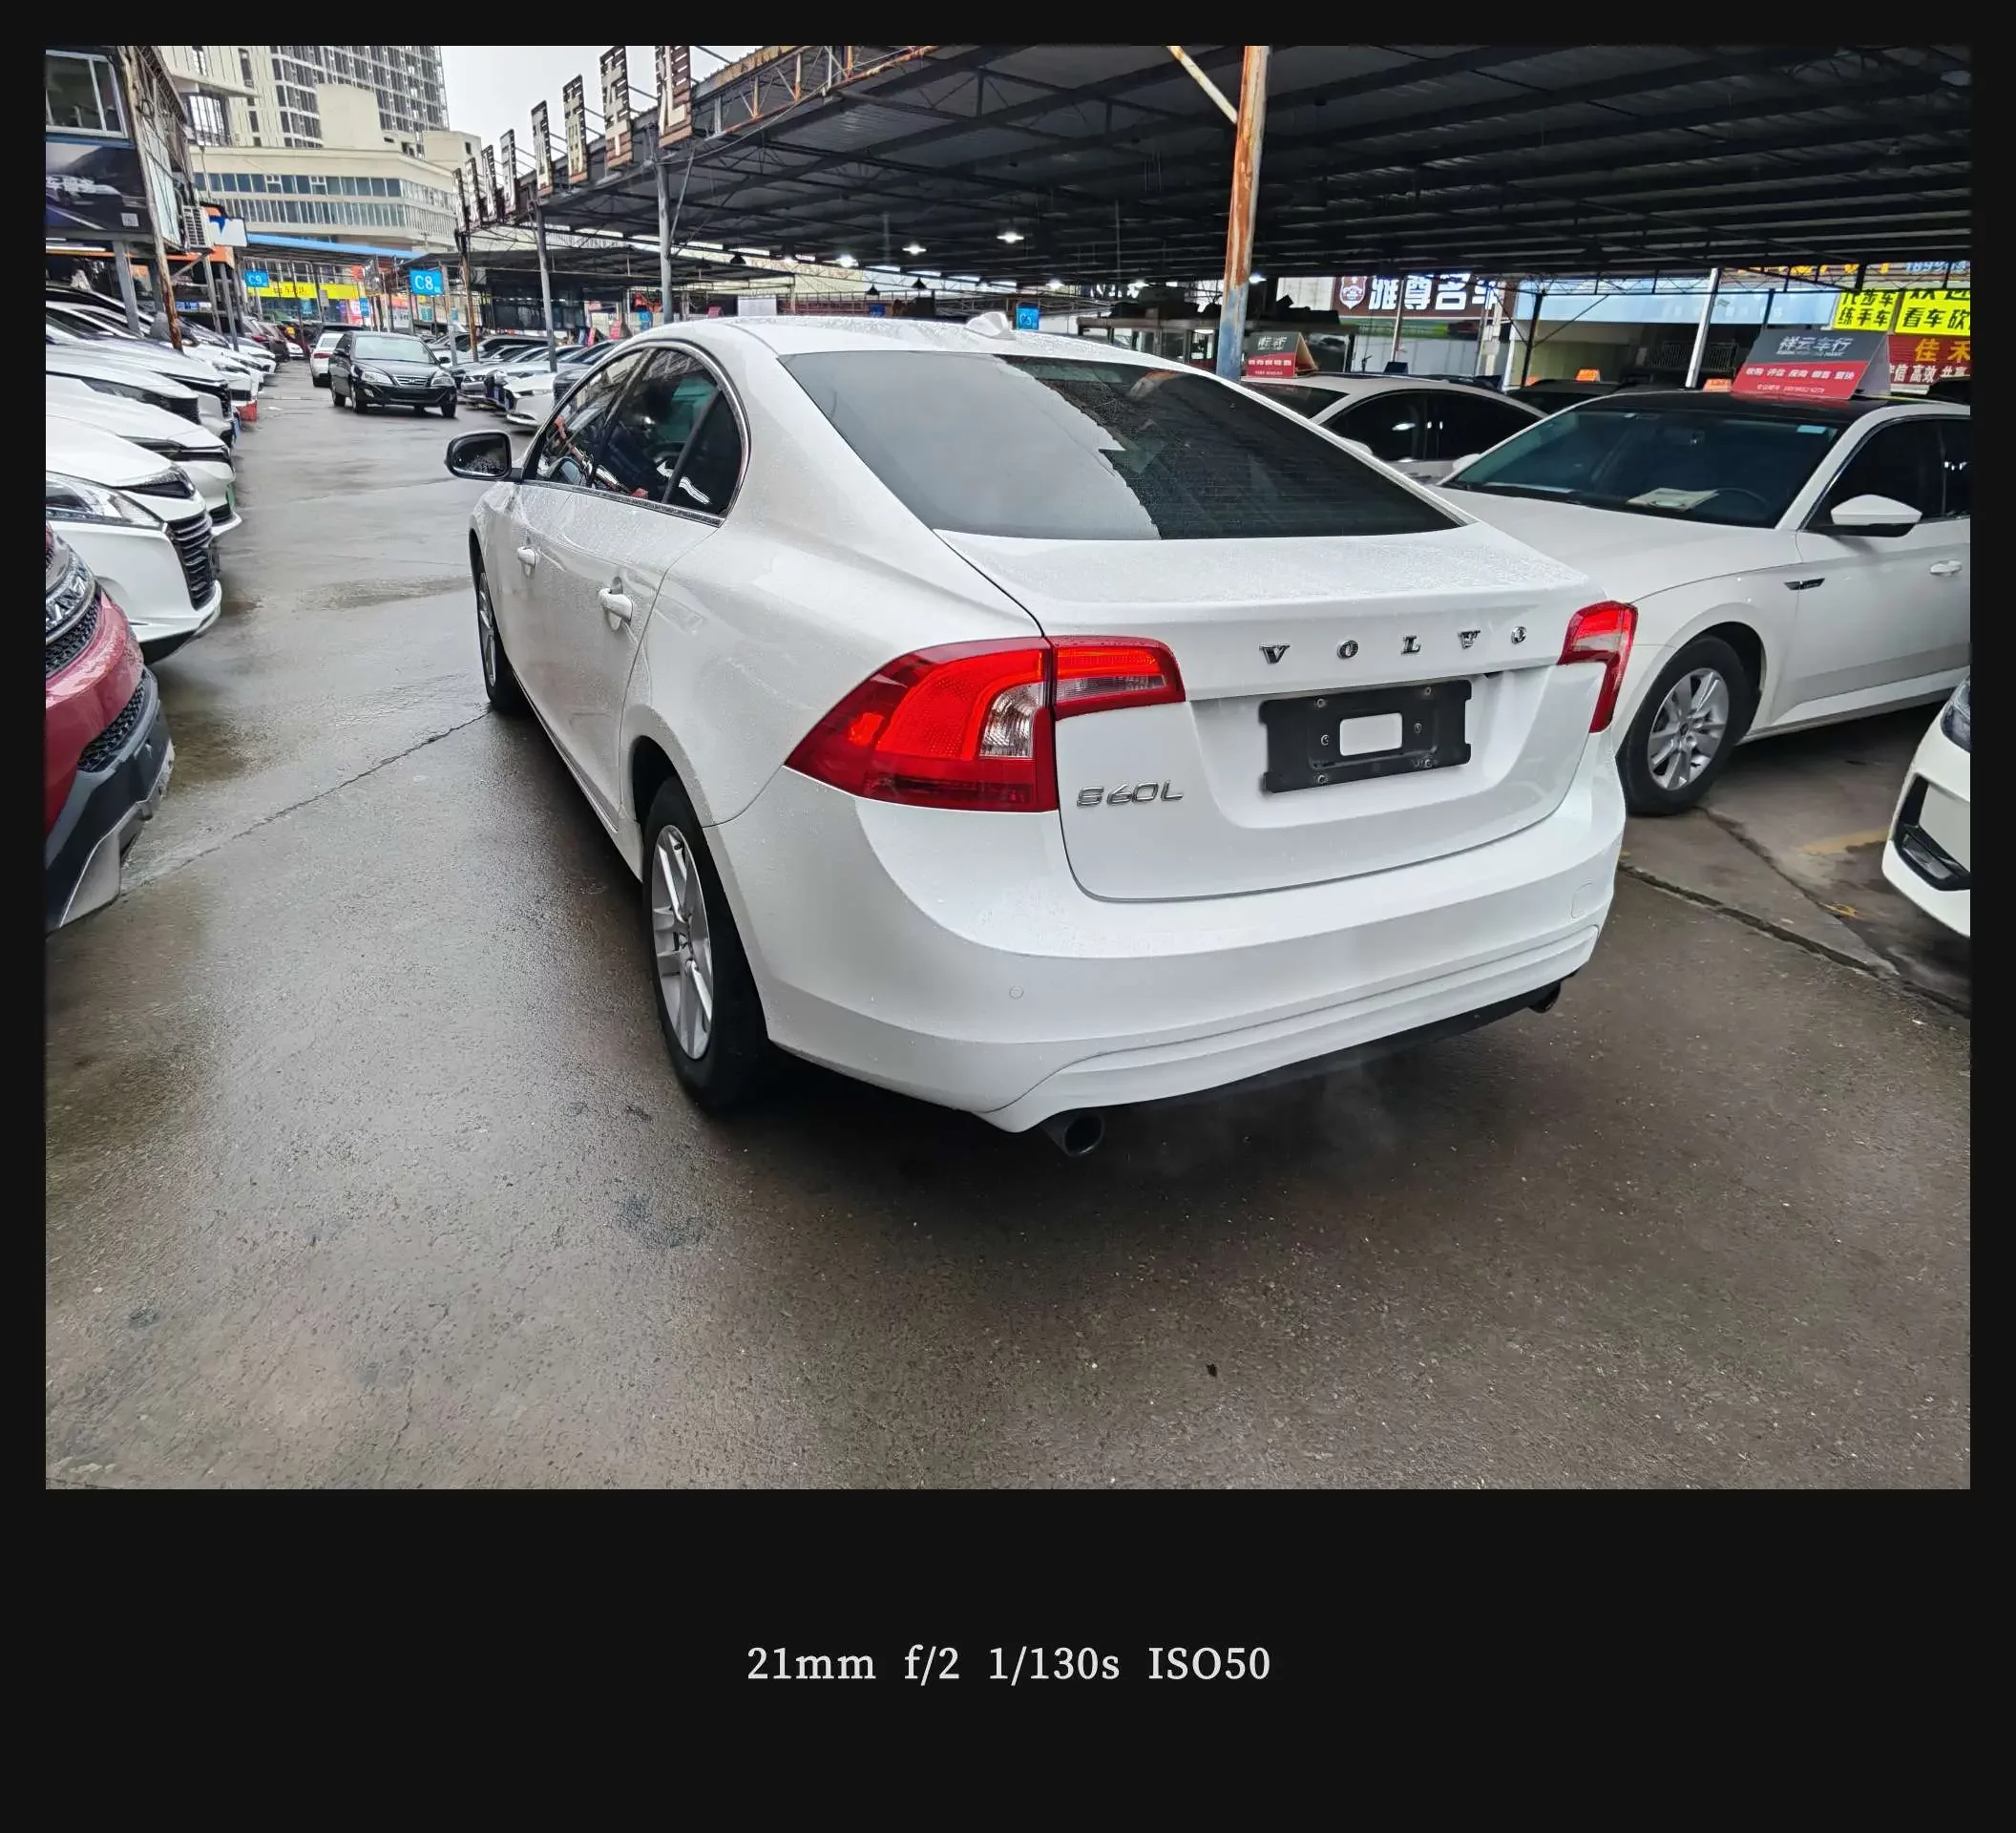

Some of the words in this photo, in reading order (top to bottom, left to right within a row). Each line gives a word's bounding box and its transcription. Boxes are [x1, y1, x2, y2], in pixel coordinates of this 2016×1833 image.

[248, 274, 262, 284] C9
[414, 275, 433, 291] C8
[1838, 306, 1891, 327] 练手车
[1902, 307, 1970, 330] 看车砍
[1779, 336, 1855, 353] 祥云车行
[1260, 625, 1527, 664] VOLVO
[1076, 780, 1184, 809] S60L
